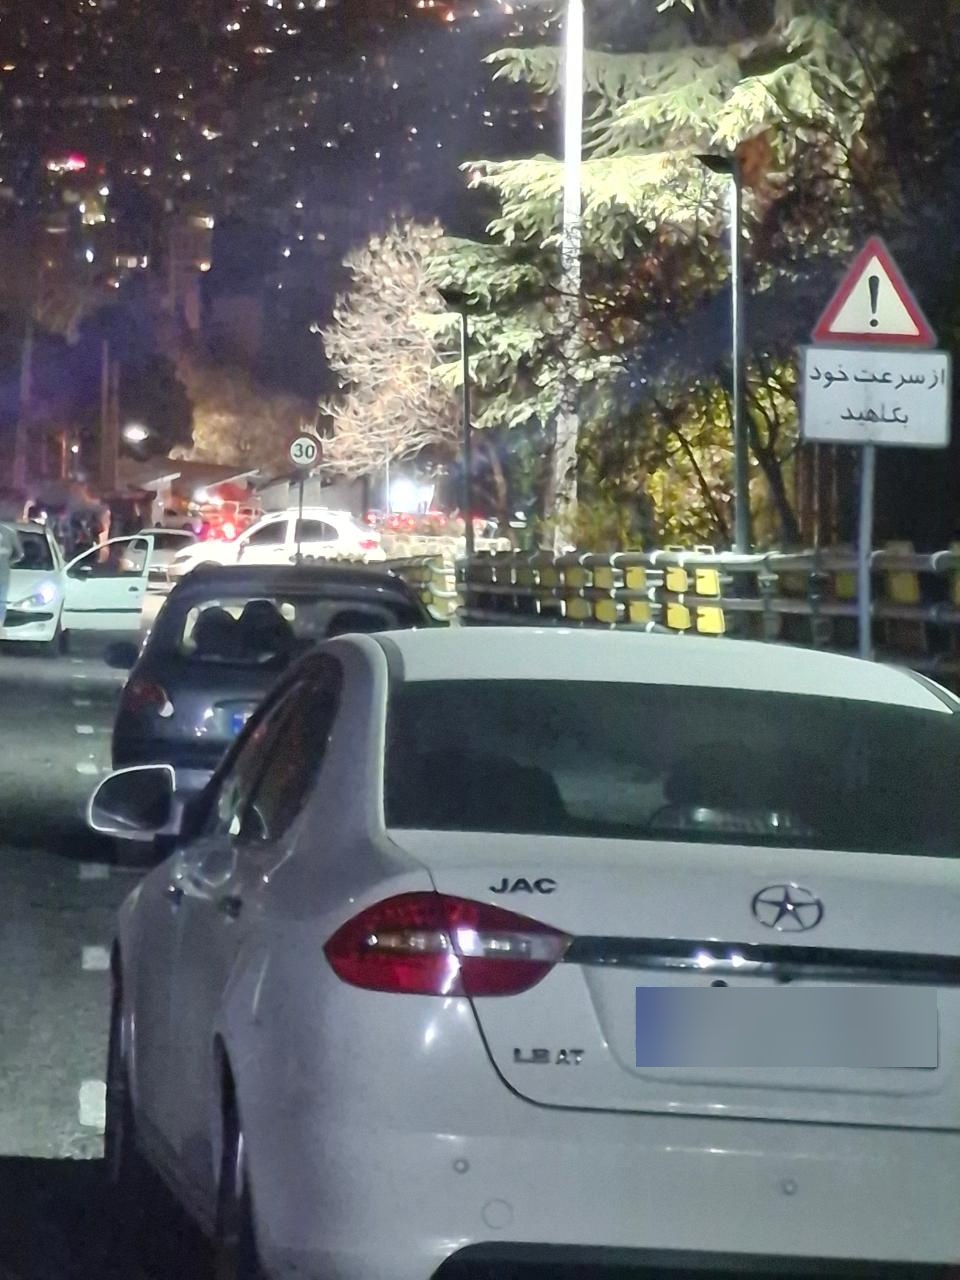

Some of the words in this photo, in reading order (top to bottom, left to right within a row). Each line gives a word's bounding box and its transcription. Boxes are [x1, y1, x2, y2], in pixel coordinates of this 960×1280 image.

[809, 365, 849, 389] خود
[853, 369, 925, 390] سرعت
[928, 368, 945, 389] از
[293, 443, 315, 459] 30
[489, 877, 557, 894] JAC
